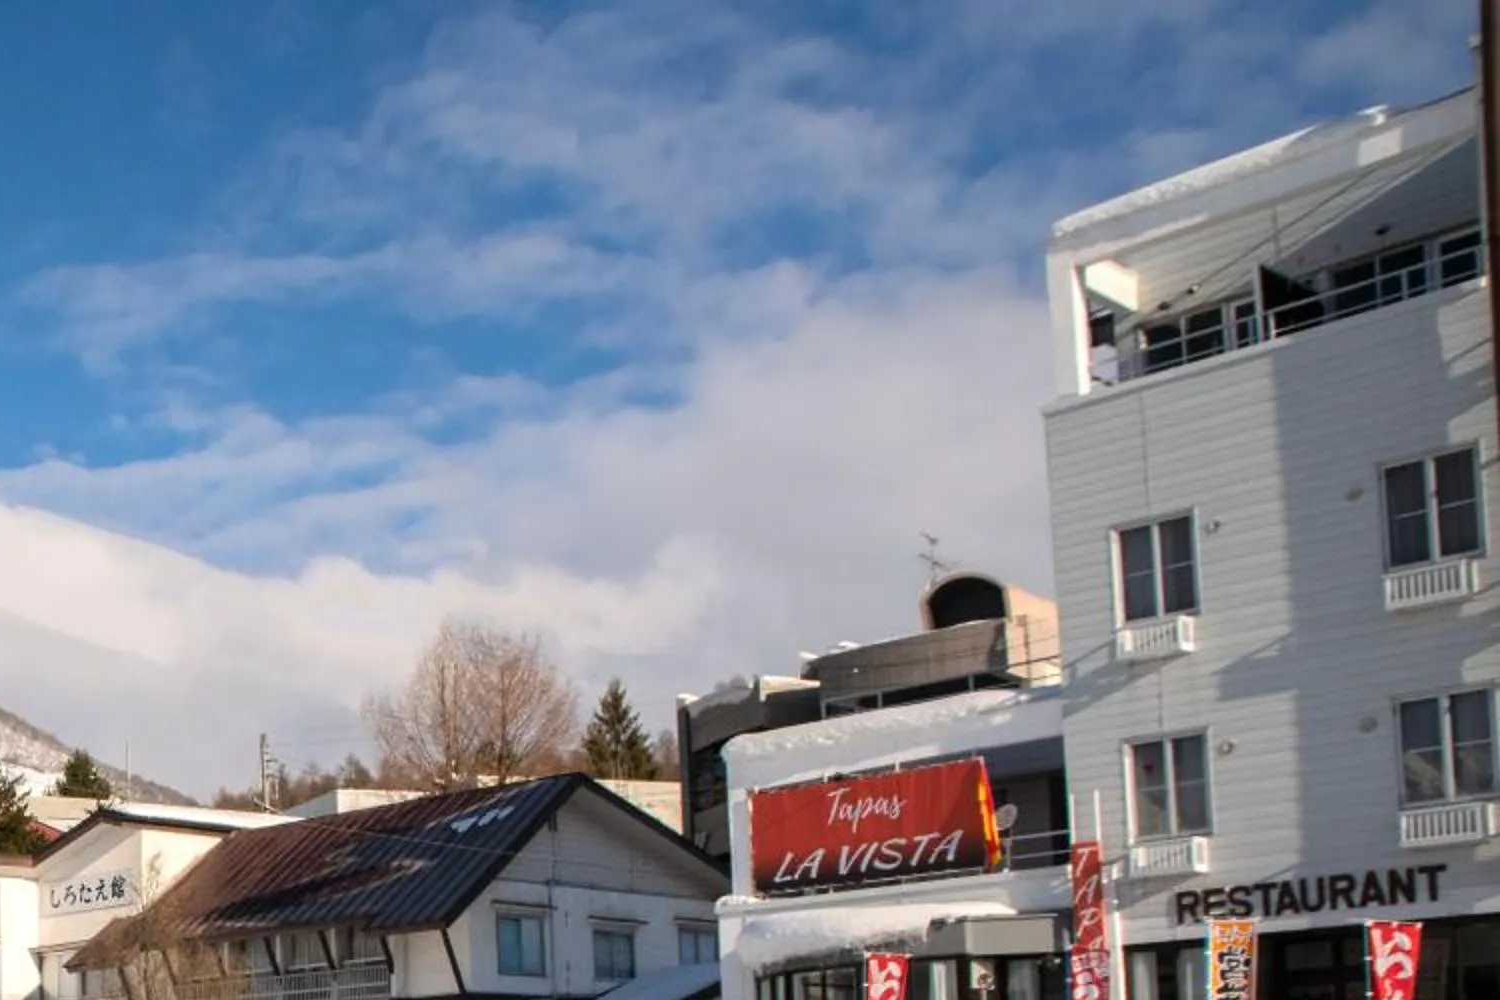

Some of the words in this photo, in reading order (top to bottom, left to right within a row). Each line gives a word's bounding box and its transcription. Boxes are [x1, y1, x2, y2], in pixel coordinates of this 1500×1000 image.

[827, 787, 907, 834] Tapas
[773, 847, 827, 884] LA
[837, 829, 965, 877] VISTA
[50, 874, 127, 908] しろたえ館
[1175, 864, 1447, 925] RESTAURANT
